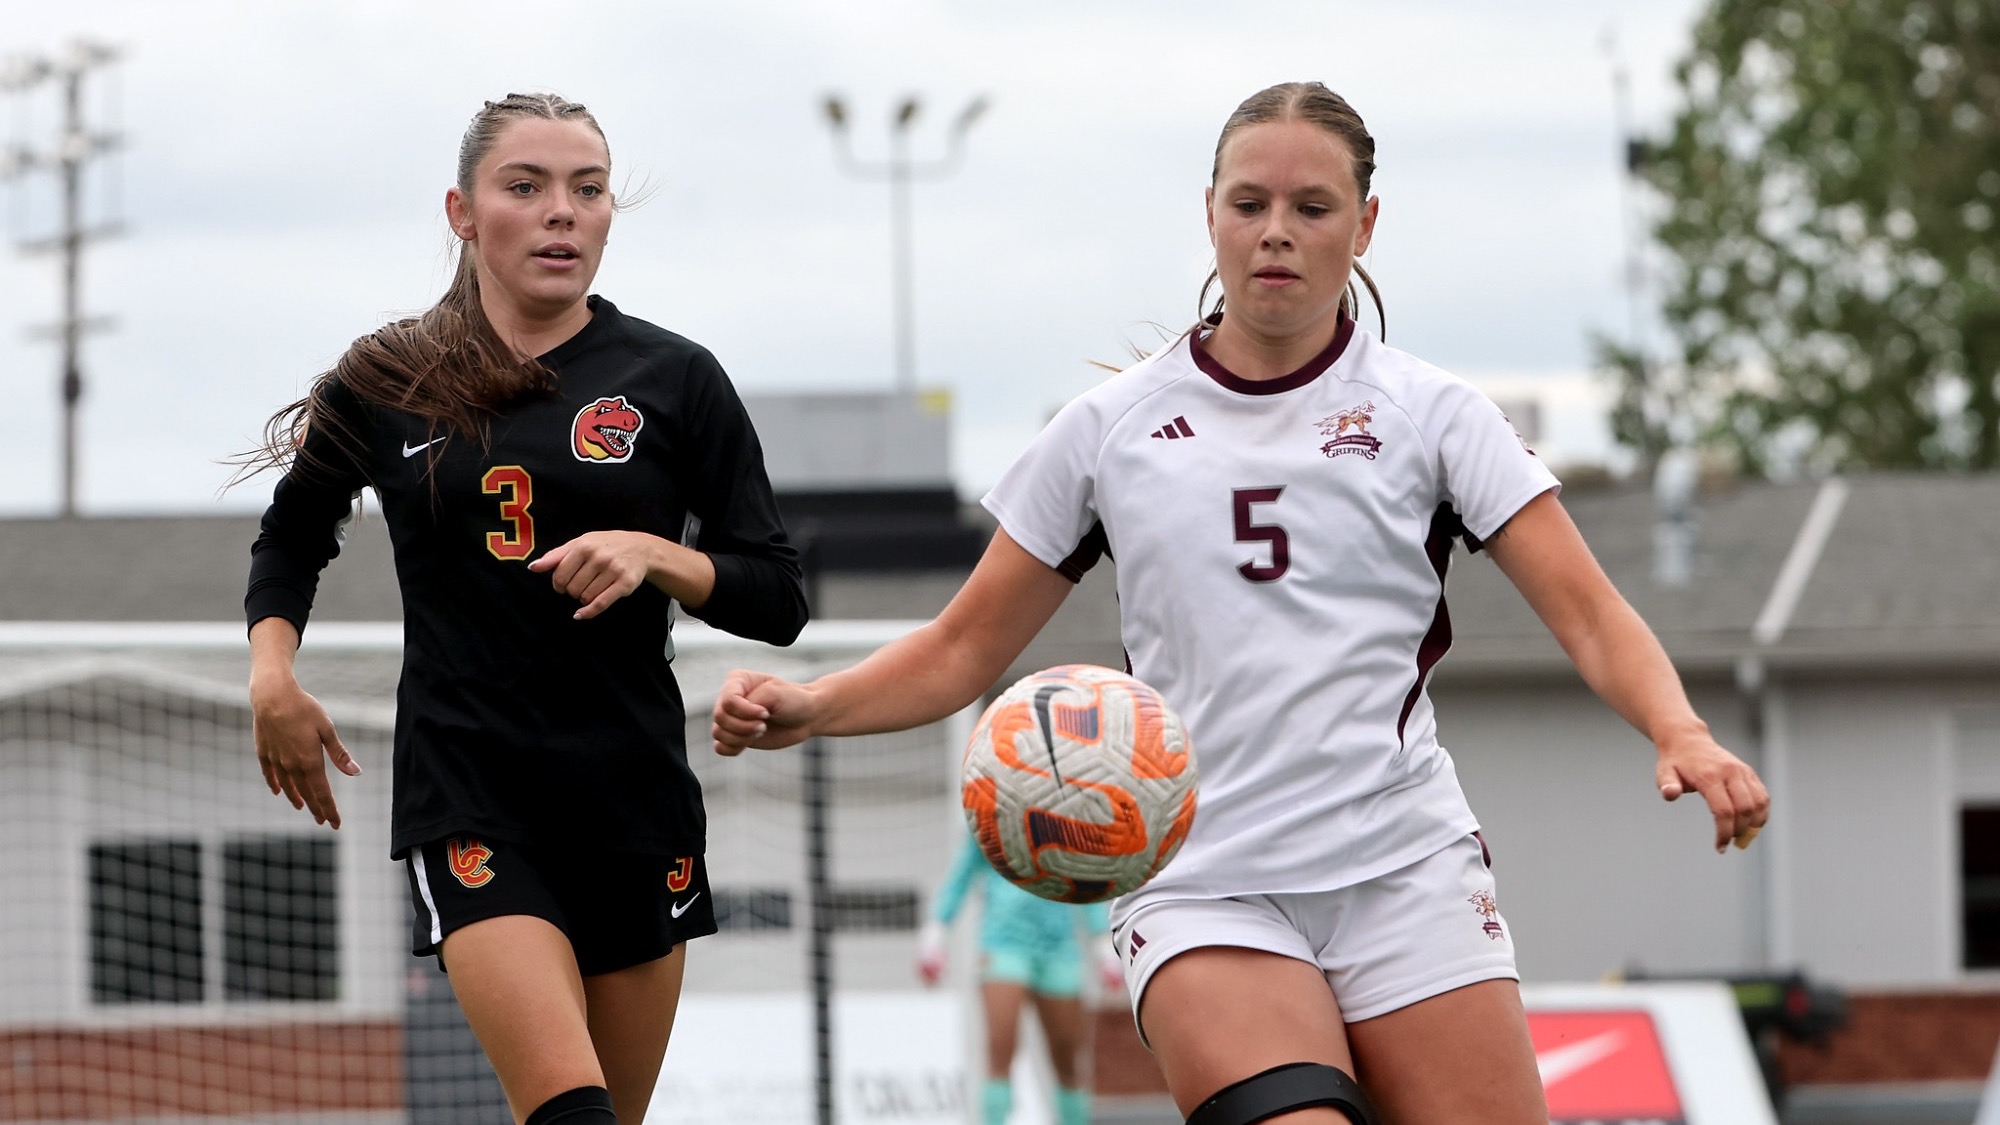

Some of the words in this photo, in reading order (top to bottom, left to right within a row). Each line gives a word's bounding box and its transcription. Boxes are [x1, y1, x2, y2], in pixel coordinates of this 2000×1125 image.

[1326, 447, 1376, 460] GRIFFINS
[481, 465, 535, 560] 3
[1231, 484, 1291, 584] 5
[447, 837, 495, 888] UC
